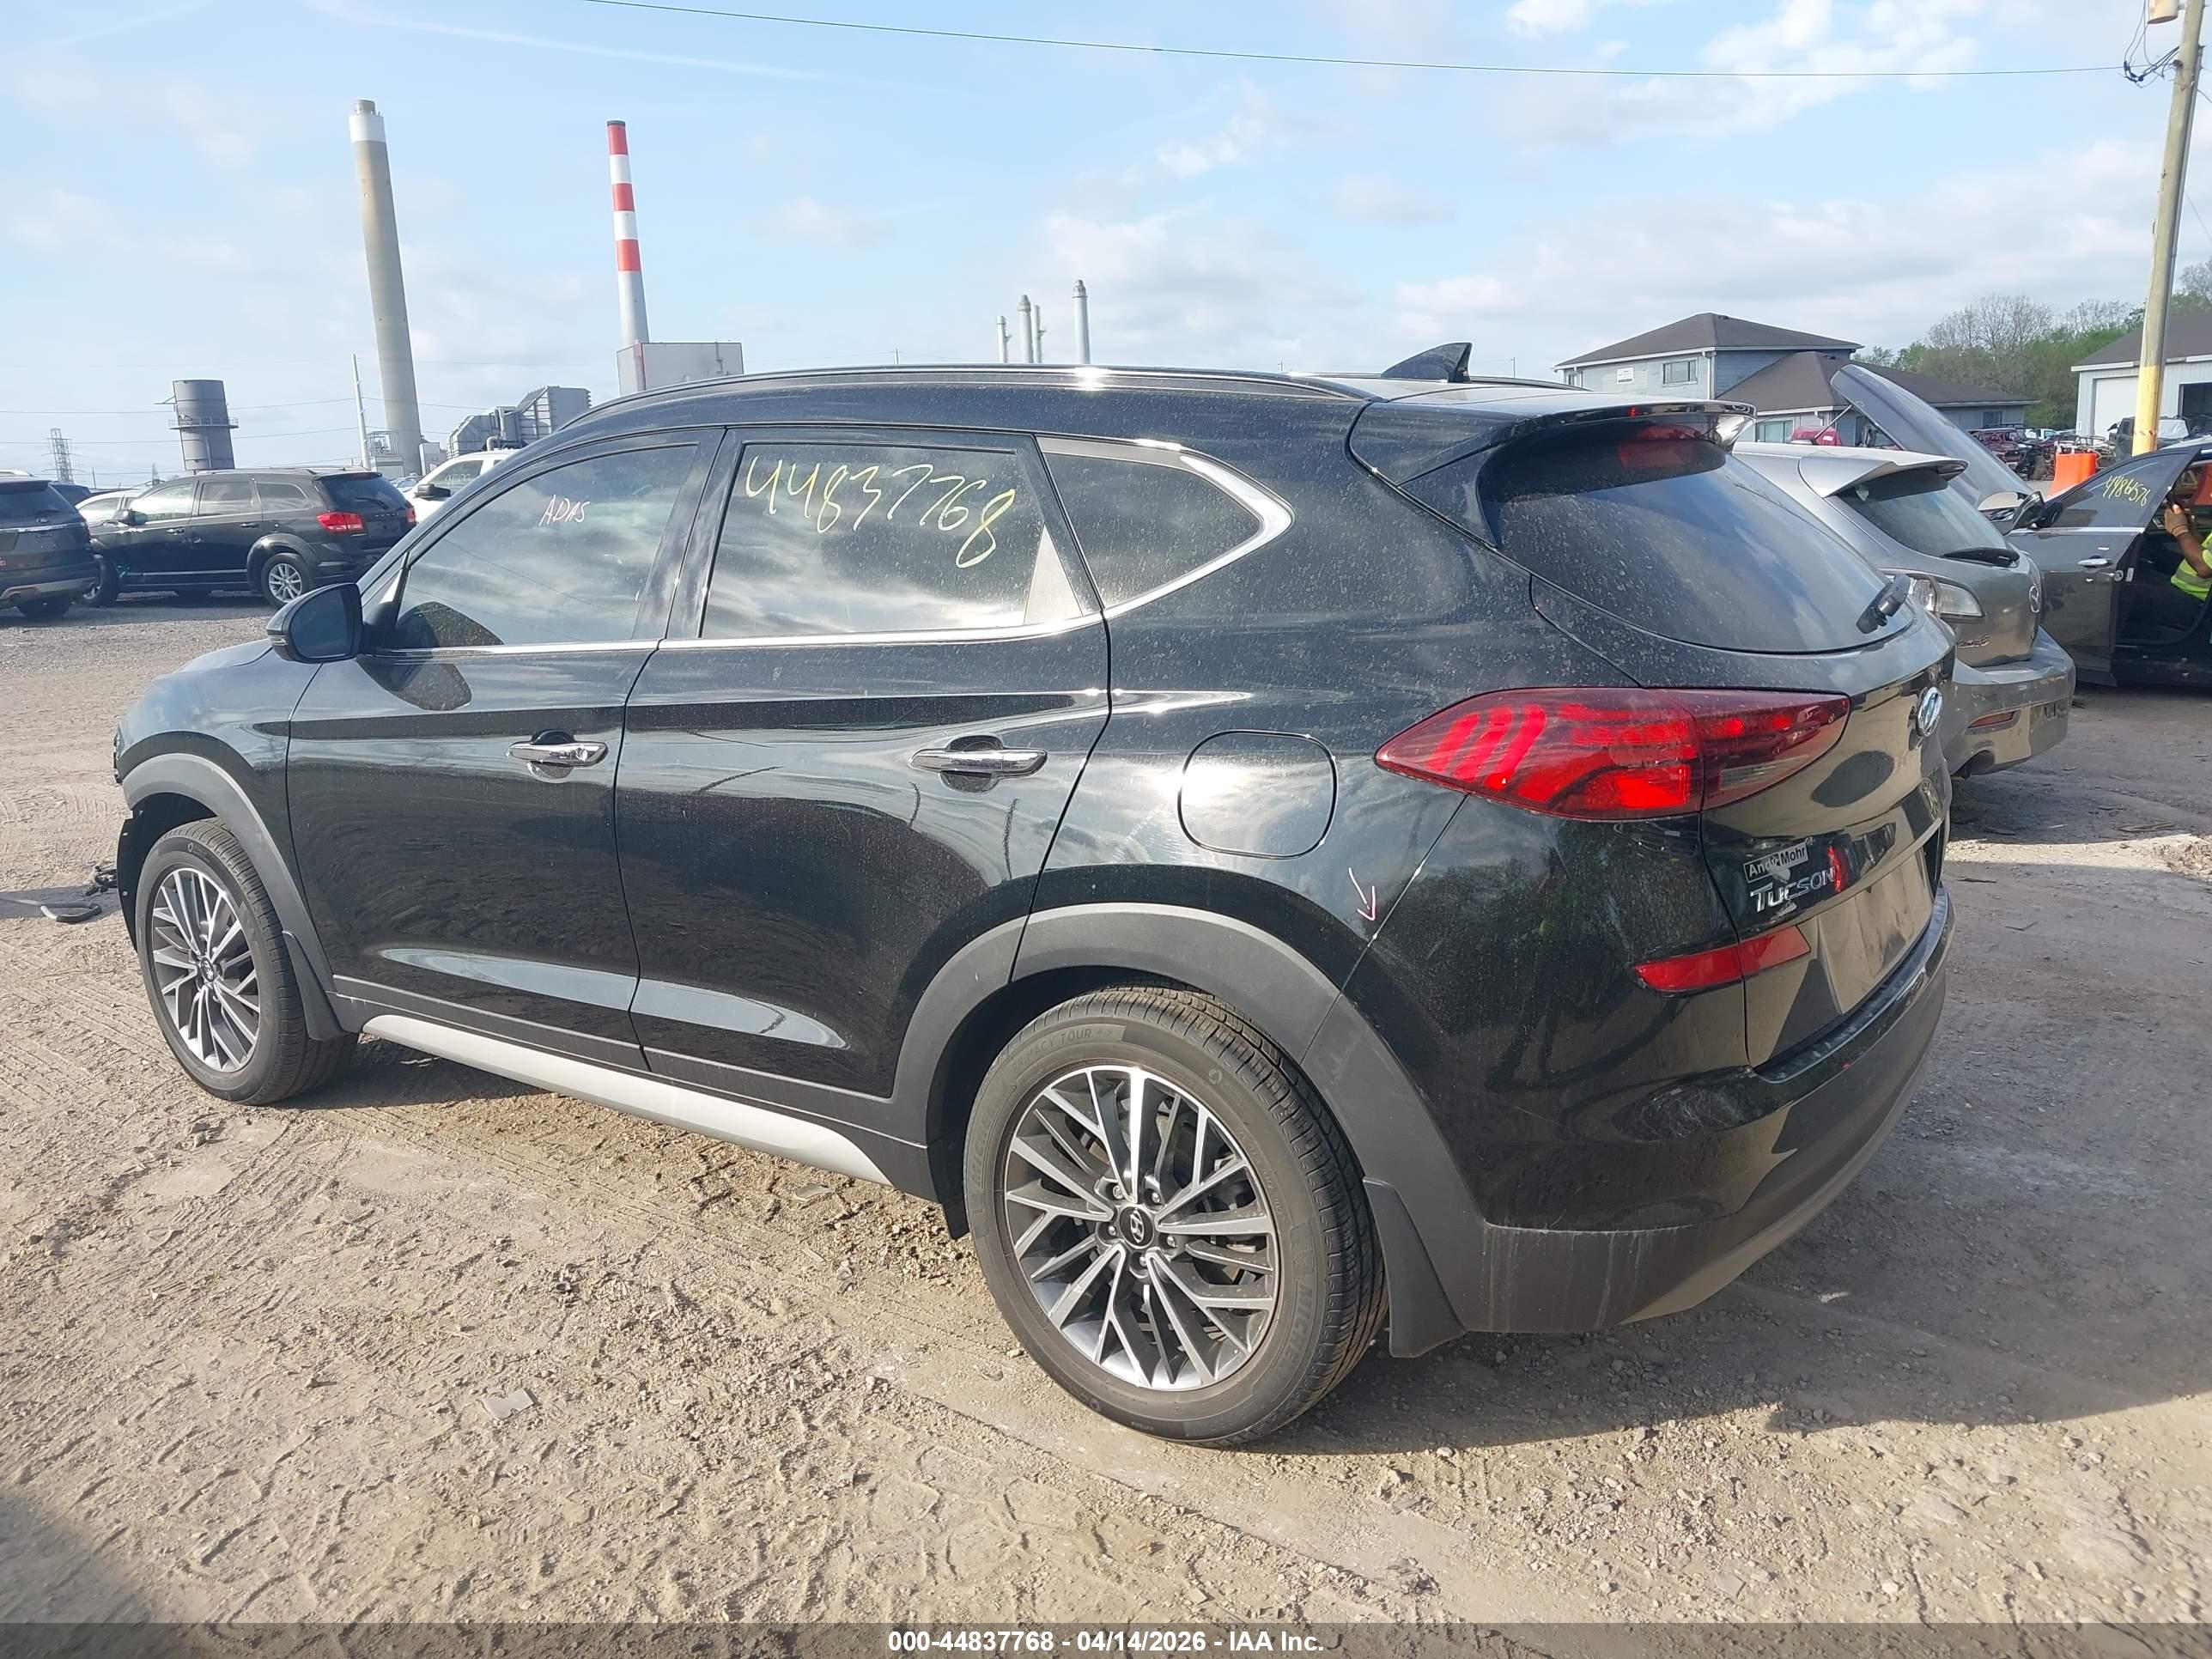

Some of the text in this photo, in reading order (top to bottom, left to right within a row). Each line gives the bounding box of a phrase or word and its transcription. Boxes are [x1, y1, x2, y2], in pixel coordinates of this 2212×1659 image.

[538, 494, 590, 526] ADAS
[745, 455, 1016, 568] 44837768
[1780, 847, 1805, 865] Mohr
[1750, 866, 1835, 912] TUCSON
[1060, 1028, 1092, 1043] TOUR
